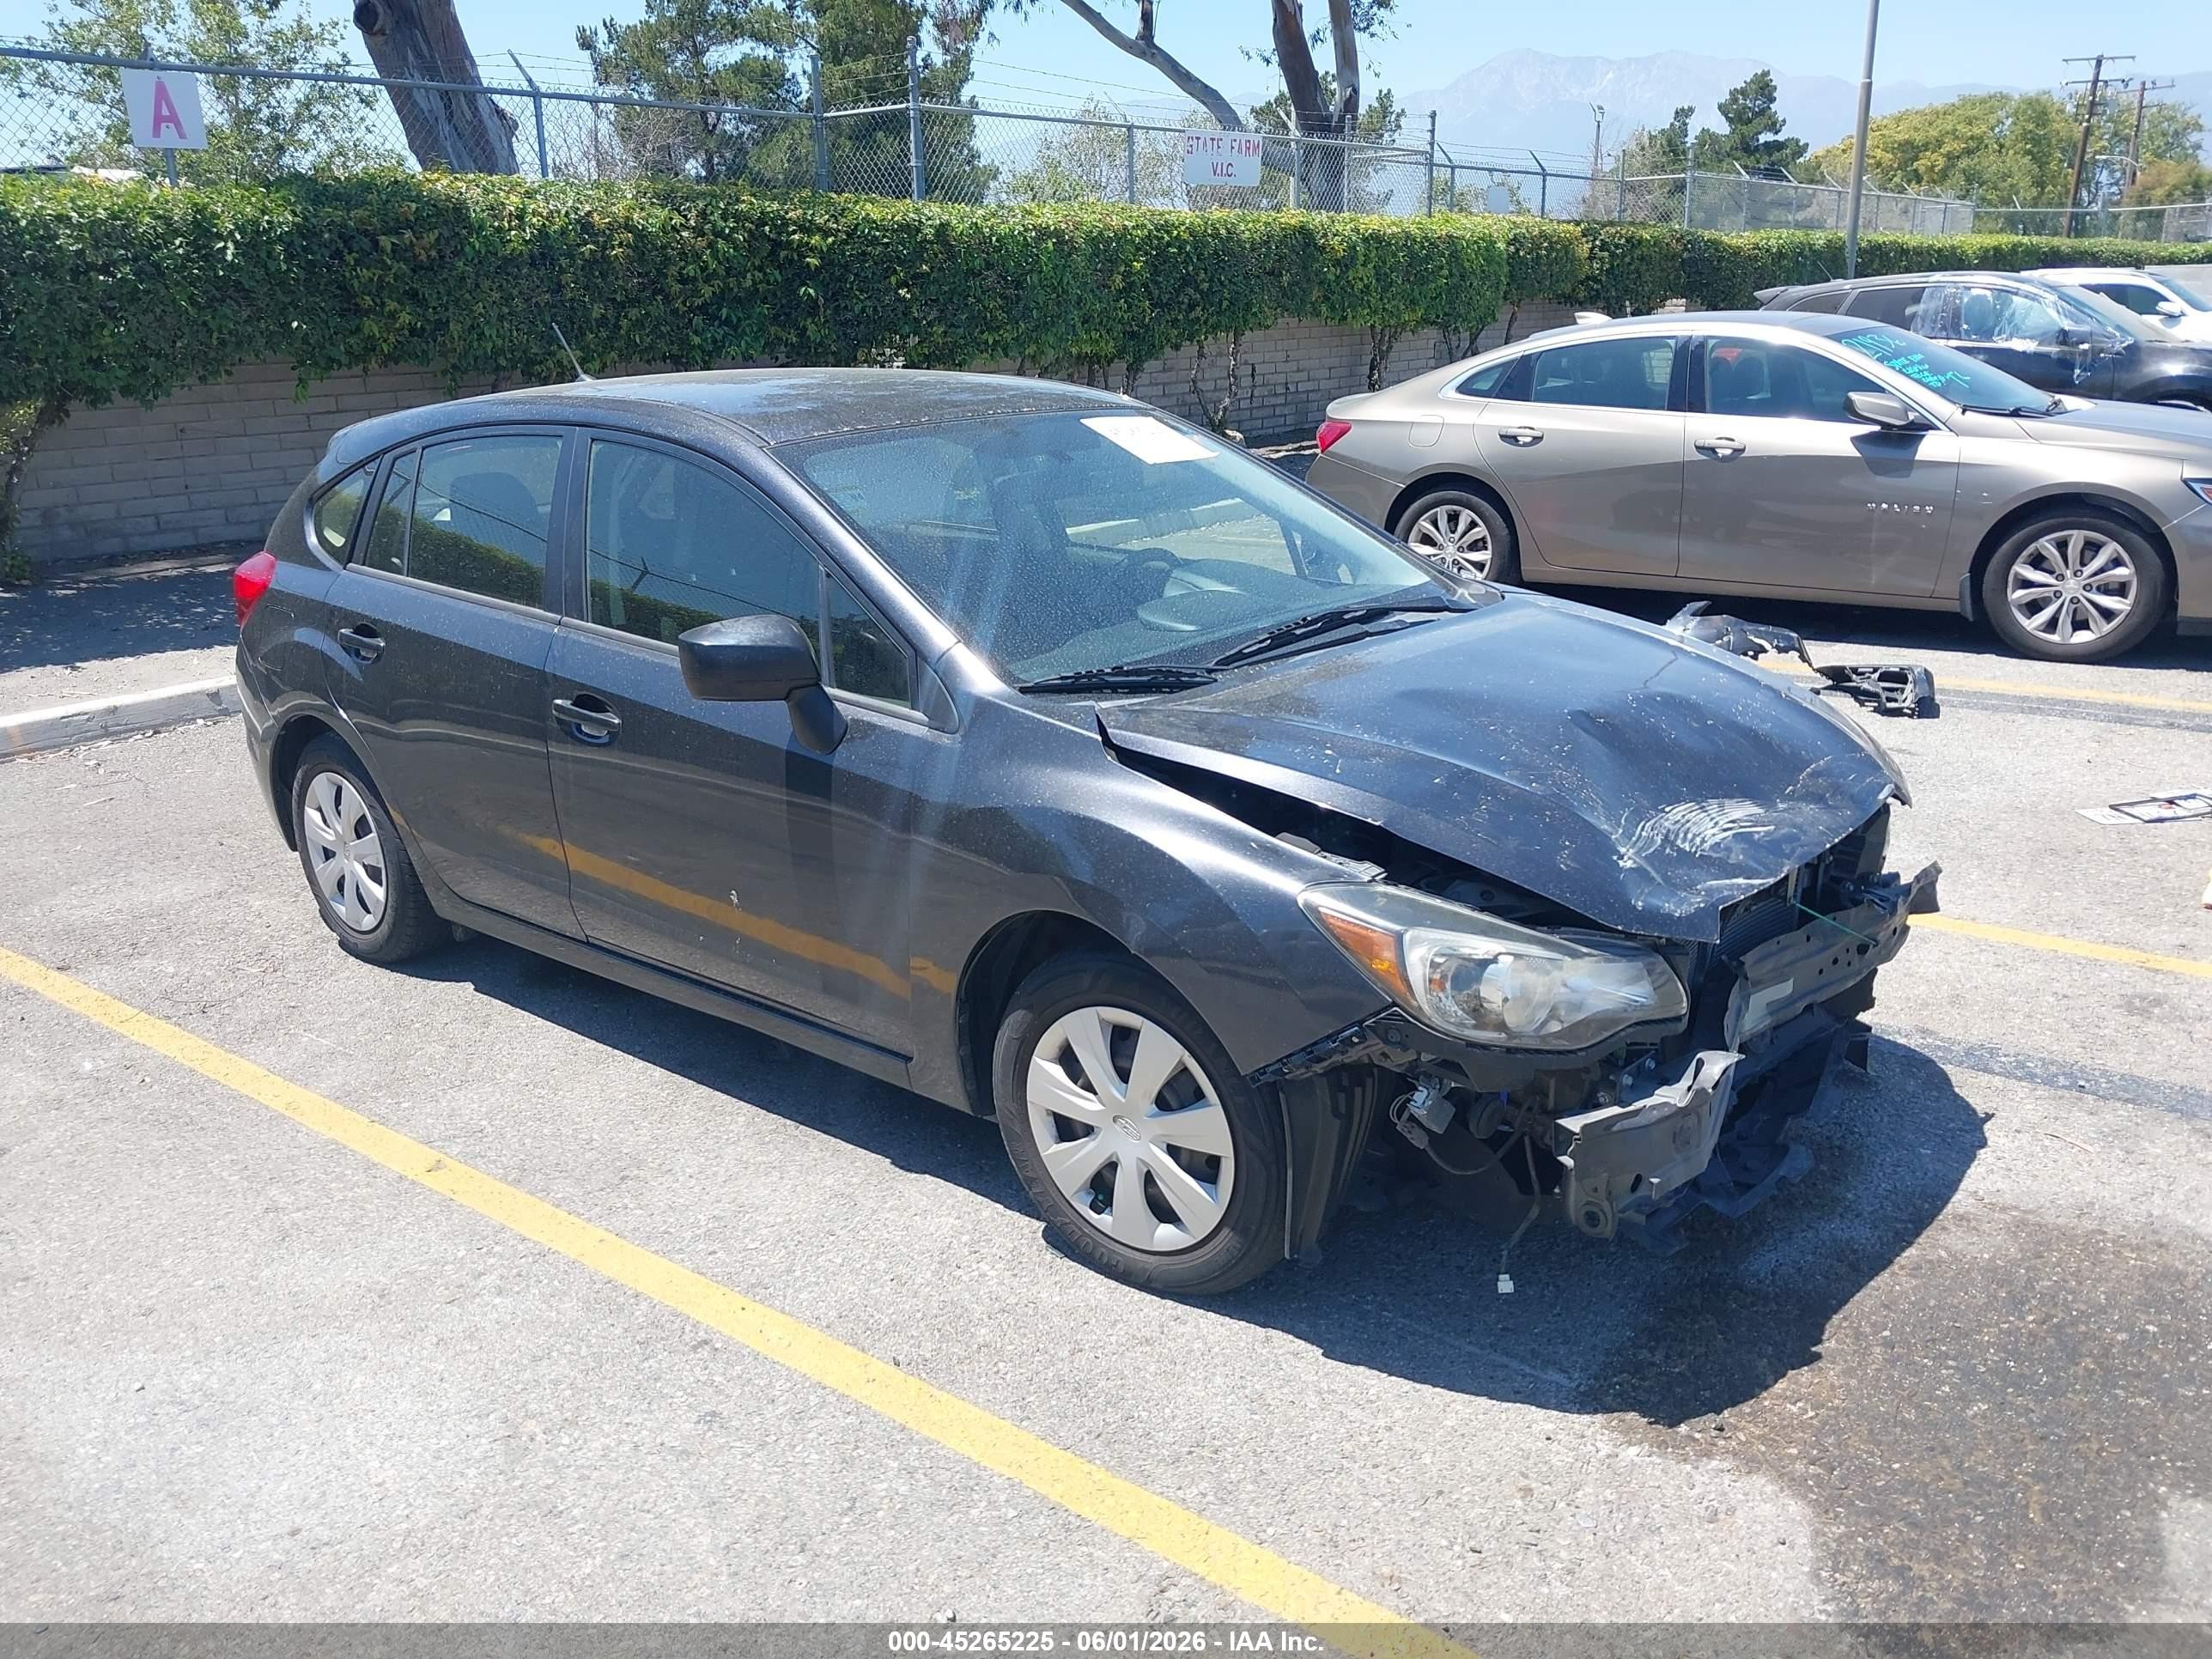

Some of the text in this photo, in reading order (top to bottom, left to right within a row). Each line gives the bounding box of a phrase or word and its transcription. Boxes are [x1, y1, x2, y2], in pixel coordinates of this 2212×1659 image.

[152, 80, 188, 139] A
[1187, 136, 1261, 158] STATE FARM
[1211, 161, 1237, 178] V.I.C.
